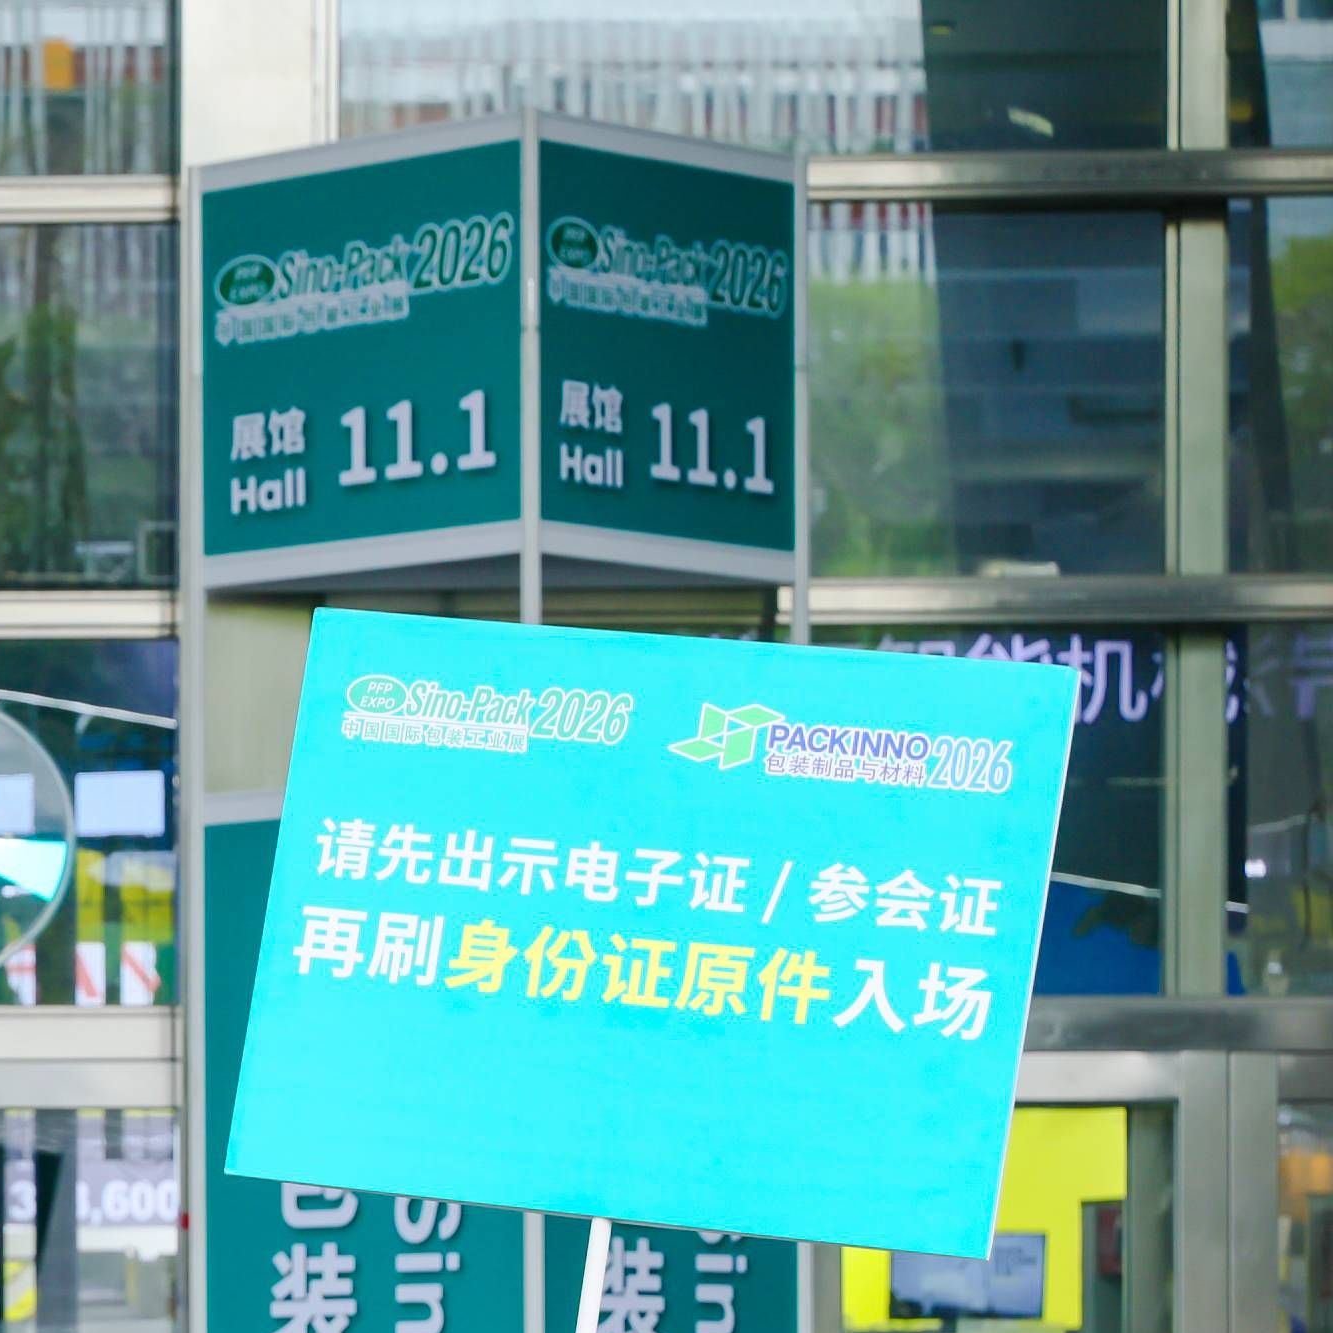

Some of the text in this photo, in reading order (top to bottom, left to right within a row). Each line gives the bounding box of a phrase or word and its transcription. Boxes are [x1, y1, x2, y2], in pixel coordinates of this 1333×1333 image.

[278, 215, 512, 299] Sino-Pack 2026
[710, 244, 786, 314] 2026
[231, 406, 306, 462] 展馆
[231, 389, 497, 516] Hall 11.1
[559, 402, 775, 495] Hall 11.1
[359, 695, 396, 710] EXPO
[367, 680, 394, 694] PFP
[405, 680, 632, 745] Sino-Pack 2026
[342, 717, 529, 753] 中国国际包装工业展
[765, 753, 926, 785] 包装制品与材料
[767, 724, 1013, 794] PACKINNO 2026
[314, 816, 751, 915] 请先出示电子证
[807, 860, 1003, 937] 参会证
[291, 904, 994, 1043] 再刷身份证原件入场
